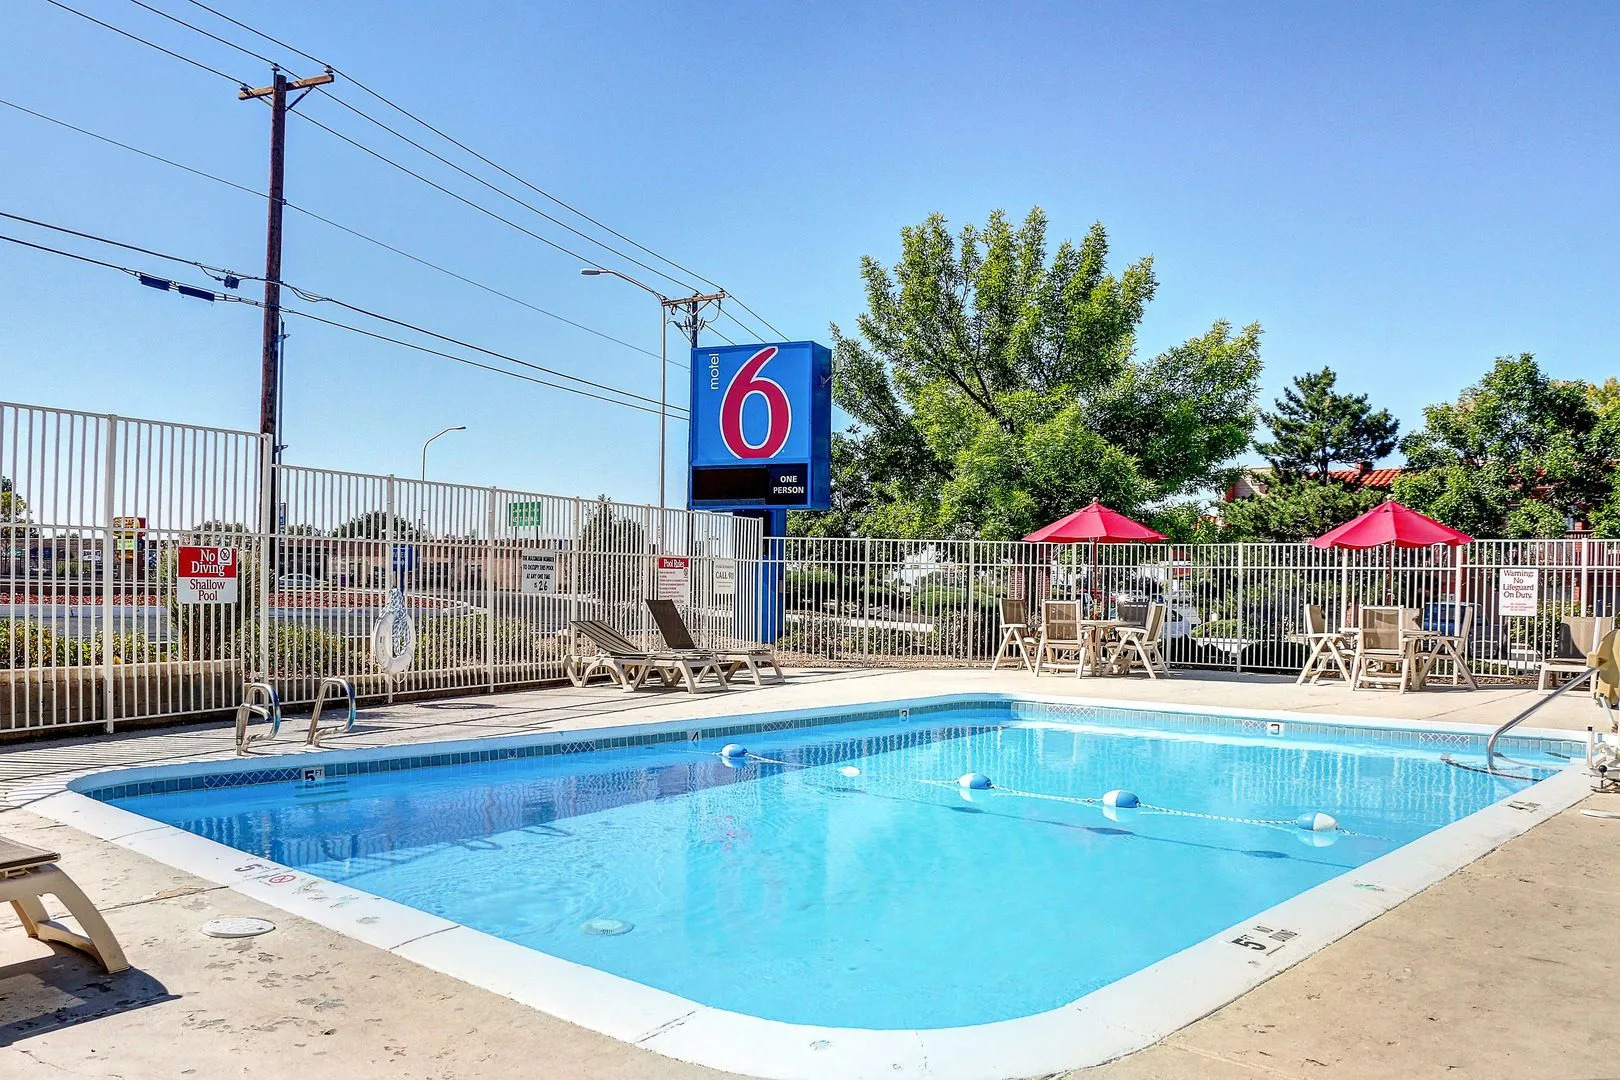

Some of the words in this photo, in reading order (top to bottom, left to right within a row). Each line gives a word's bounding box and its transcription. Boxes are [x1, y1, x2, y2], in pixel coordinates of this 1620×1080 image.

[709, 353, 720, 390] motel
[719, 345, 793, 459] 6
[780, 475, 798, 483] ONE
[773, 486, 805, 494] PERSON
[200, 549, 216, 562] No
[191, 560, 225, 576] Diving
[663, 559, 673, 568] Pool
[673, 559, 685, 568] Rules
[715, 571, 728, 579] CALL
[190, 579, 226, 590] Shallow
[538, 581, 548, 591] 26
[198, 590, 218, 601] Pool
[1231, 938, 1267, 951] 5
